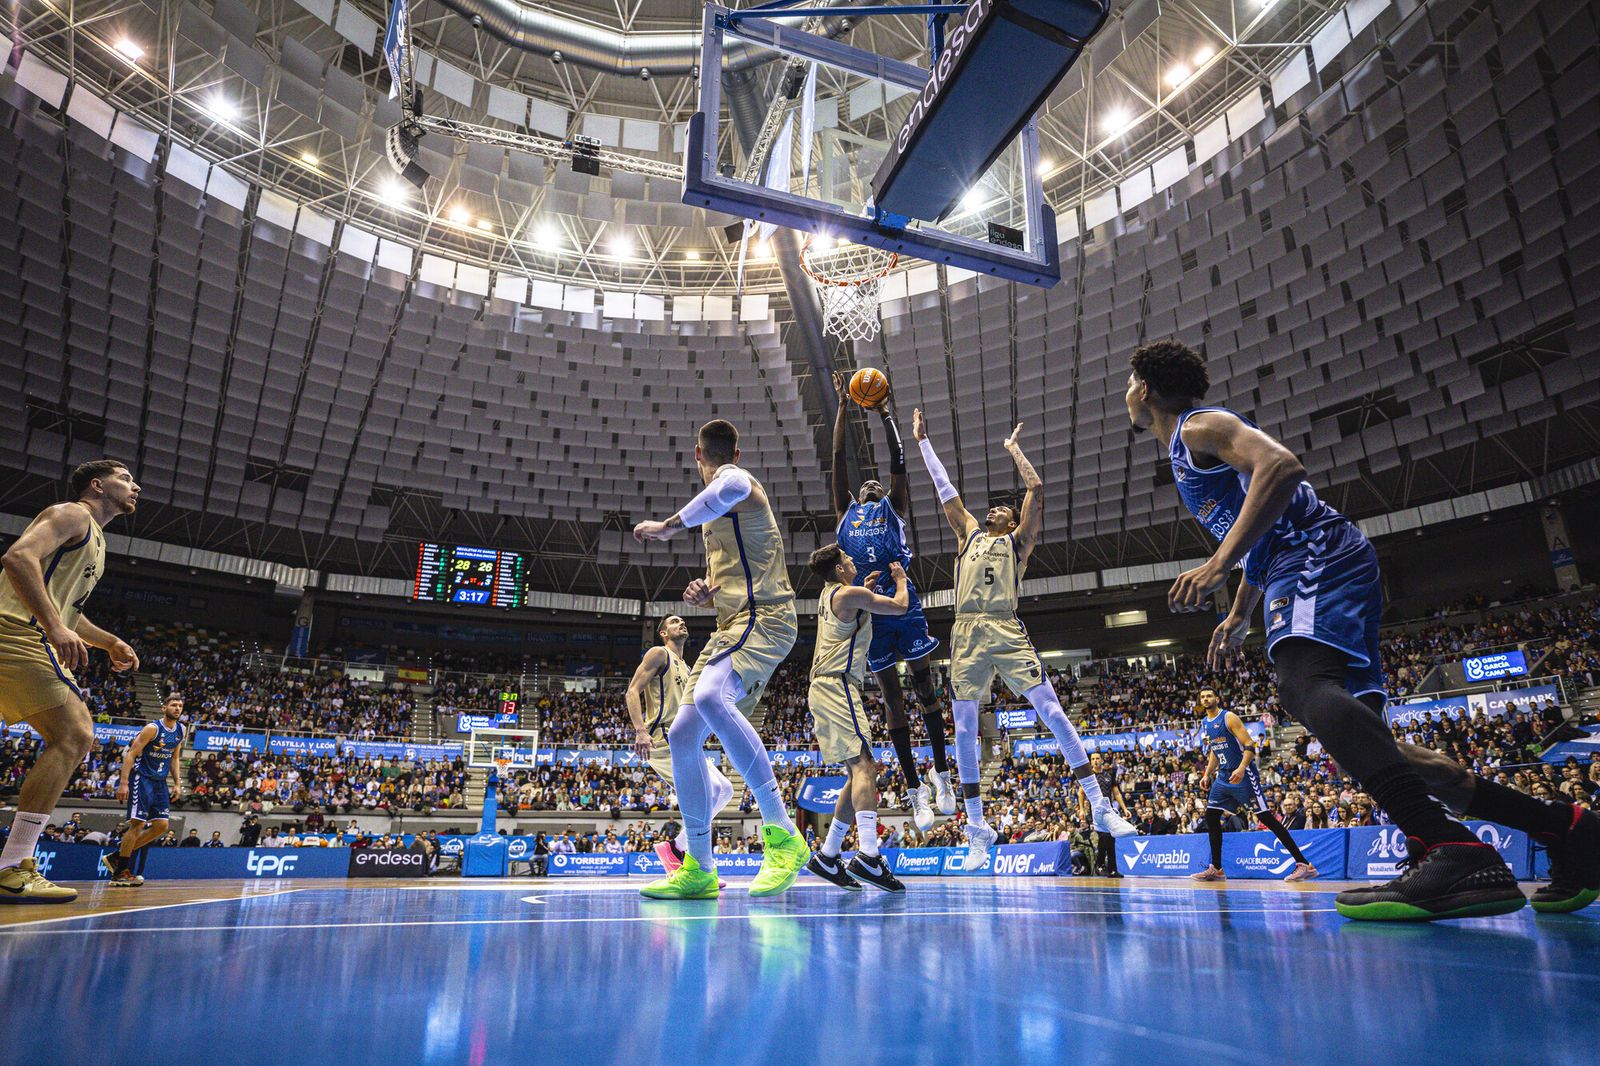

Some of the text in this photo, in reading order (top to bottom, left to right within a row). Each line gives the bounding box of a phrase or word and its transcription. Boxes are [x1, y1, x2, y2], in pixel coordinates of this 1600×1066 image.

[897, 0, 984, 154] endesa
[455, 560, 494, 573] 28 26
[985, 568, 995, 586] 5
[459, 591, 484, 602] 3:17
[1482, 655, 1507, 664] GRUPO
[1483, 661, 1510, 670] GARCÍA
[503, 702, 515, 714] 13
[208, 734, 251, 748] SUMIAL
[270, 740, 305, 748] CASTILLA
[355, 851, 423, 866] endesa
[569, 857, 624, 865] TORREPLAS
[734, 858, 745, 866] de
[994, 848, 1035, 874] biver
